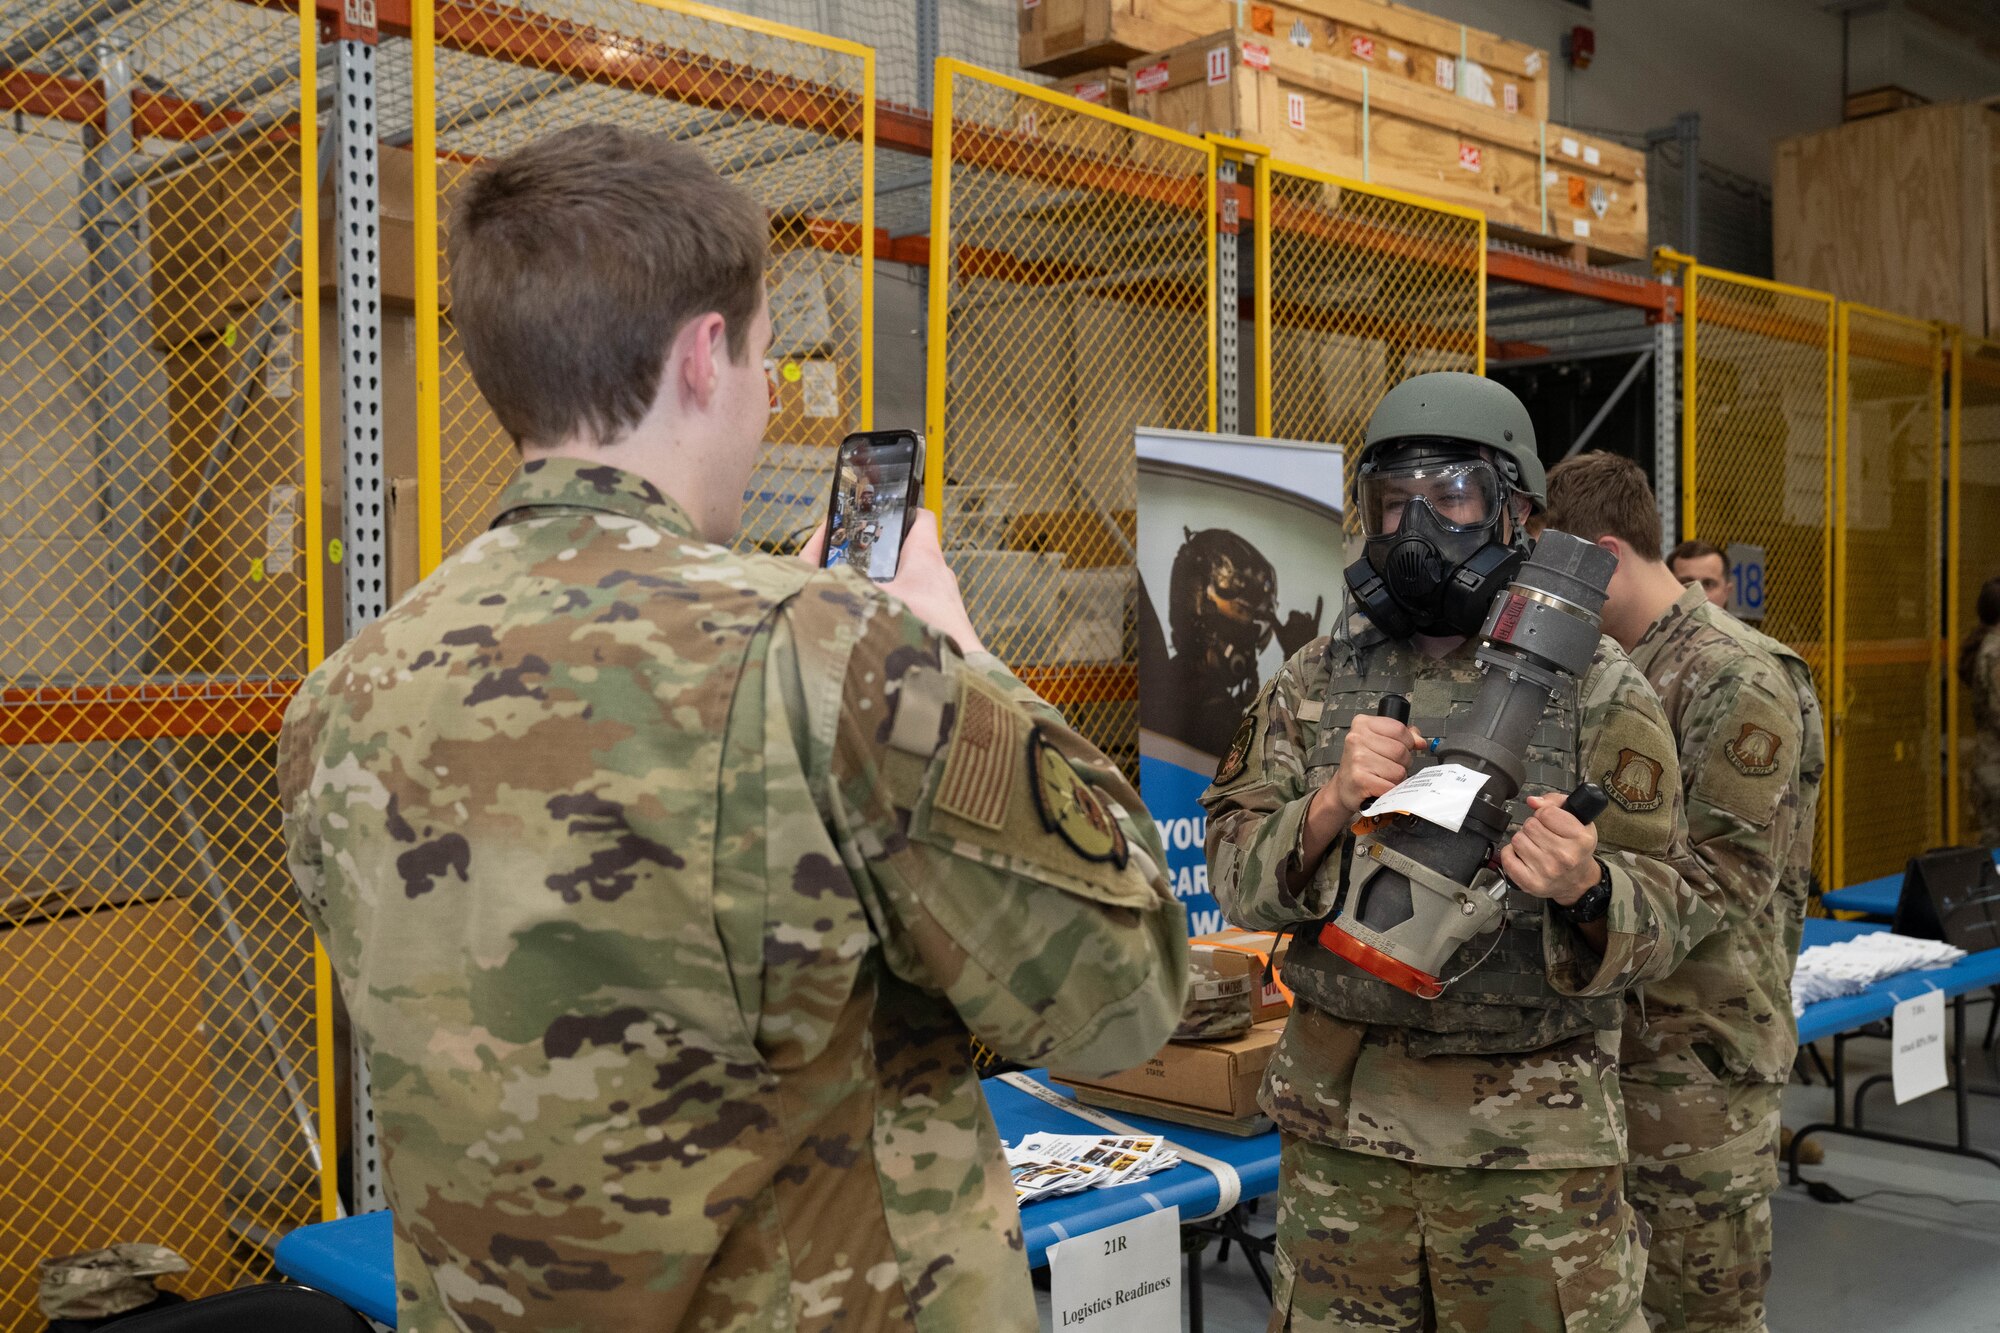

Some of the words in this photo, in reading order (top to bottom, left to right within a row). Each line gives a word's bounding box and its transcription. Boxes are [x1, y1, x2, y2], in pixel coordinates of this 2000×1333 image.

[1732, 563, 1762, 608] 18
[1605, 783, 1616, 795] AIR
[1637, 801, 1657, 809] ROTC
[1104, 1235, 1128, 1256] 21R
[1062, 1297, 1112, 1327] Logistics
[1115, 1276, 1171, 1306] Readiness
